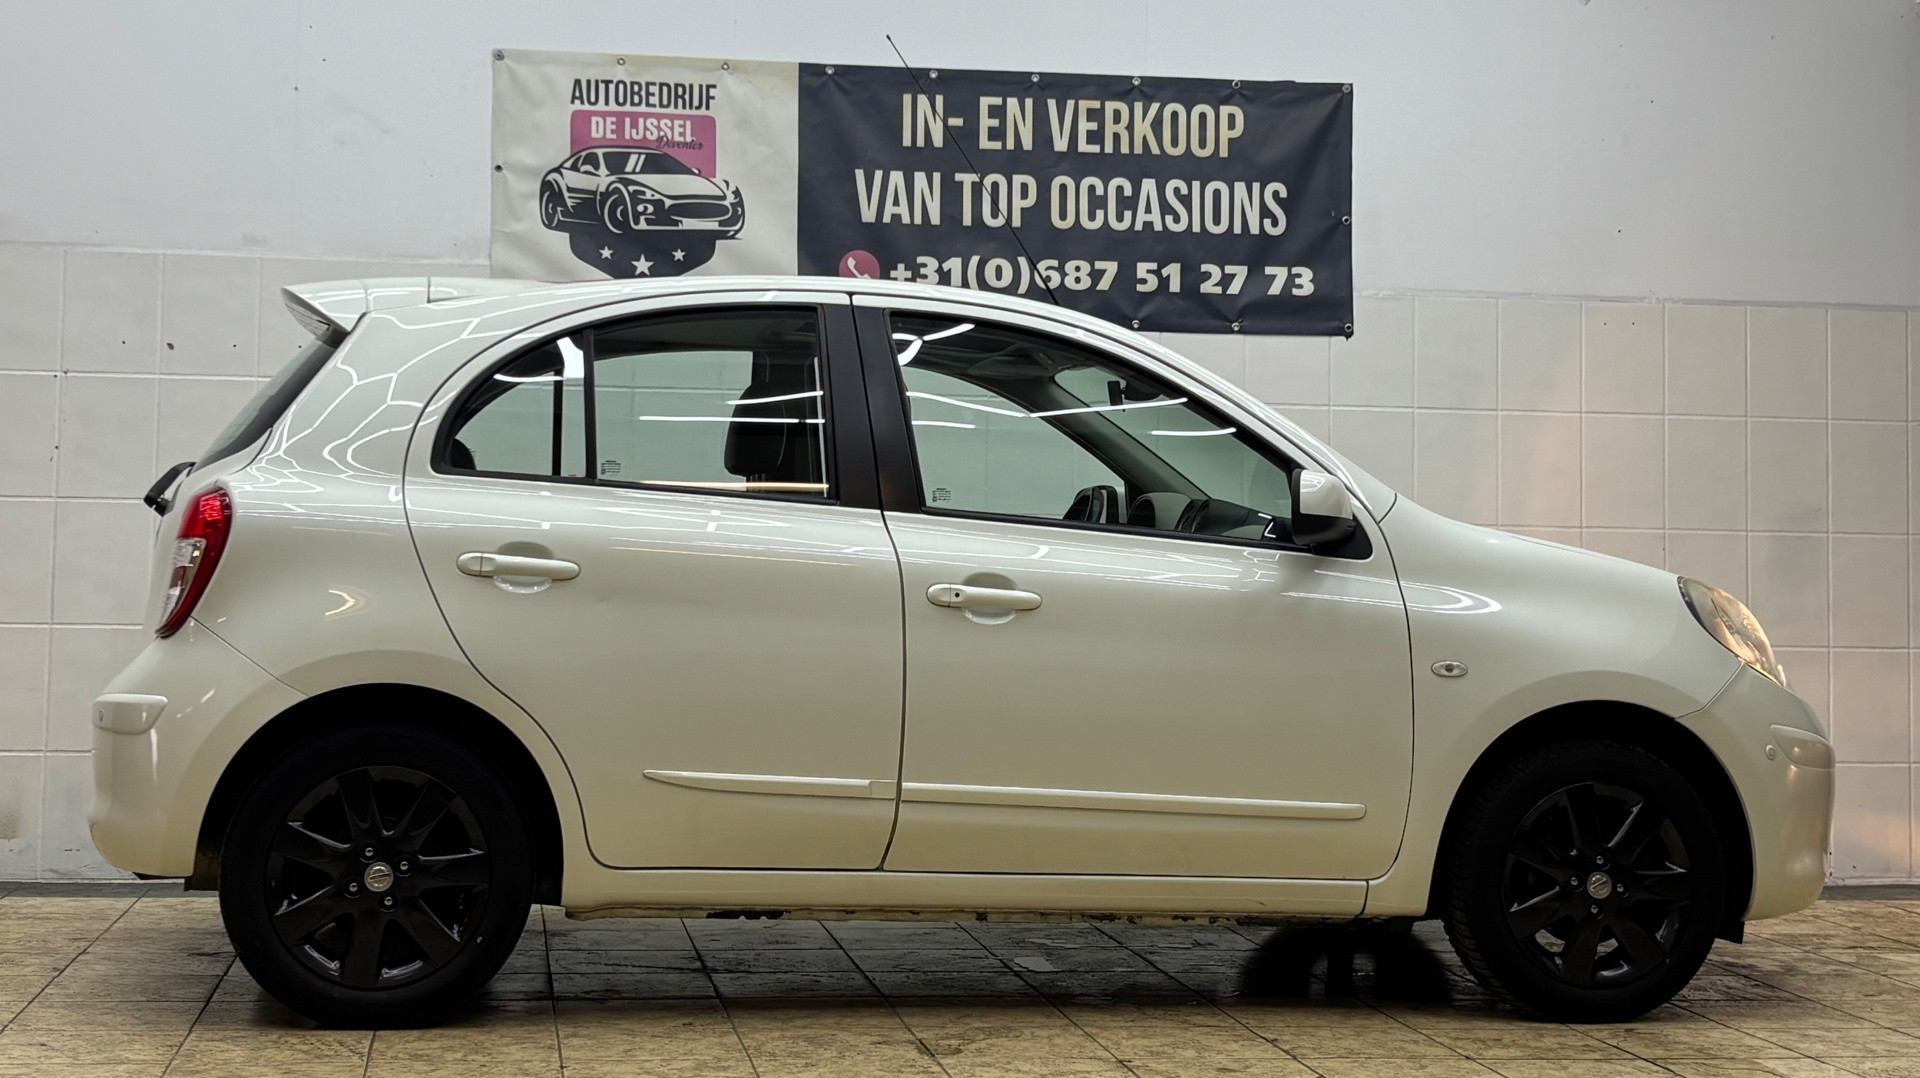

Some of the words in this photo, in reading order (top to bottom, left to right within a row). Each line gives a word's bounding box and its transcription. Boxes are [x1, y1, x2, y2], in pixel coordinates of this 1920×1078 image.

[570, 78, 717, 110] AUTOBEDRIJF
[591, 116, 617, 139] DE
[624, 117, 696, 142] IJSSEL
[902, 93, 964, 148] IN-
[978, 97, 1033, 151] EN
[1046, 99, 1245, 157] VERKOOP
[855, 169, 942, 225] VAN
[954, 173, 1037, 228] TOP
[1050, 175, 1288, 236] OCCASIONS
[889, 255, 1118, 294] +31(0)687
[1135, 262, 1182, 294] 51
[1200, 264, 1248, 295] 27
[1264, 266, 1315, 296] 73
